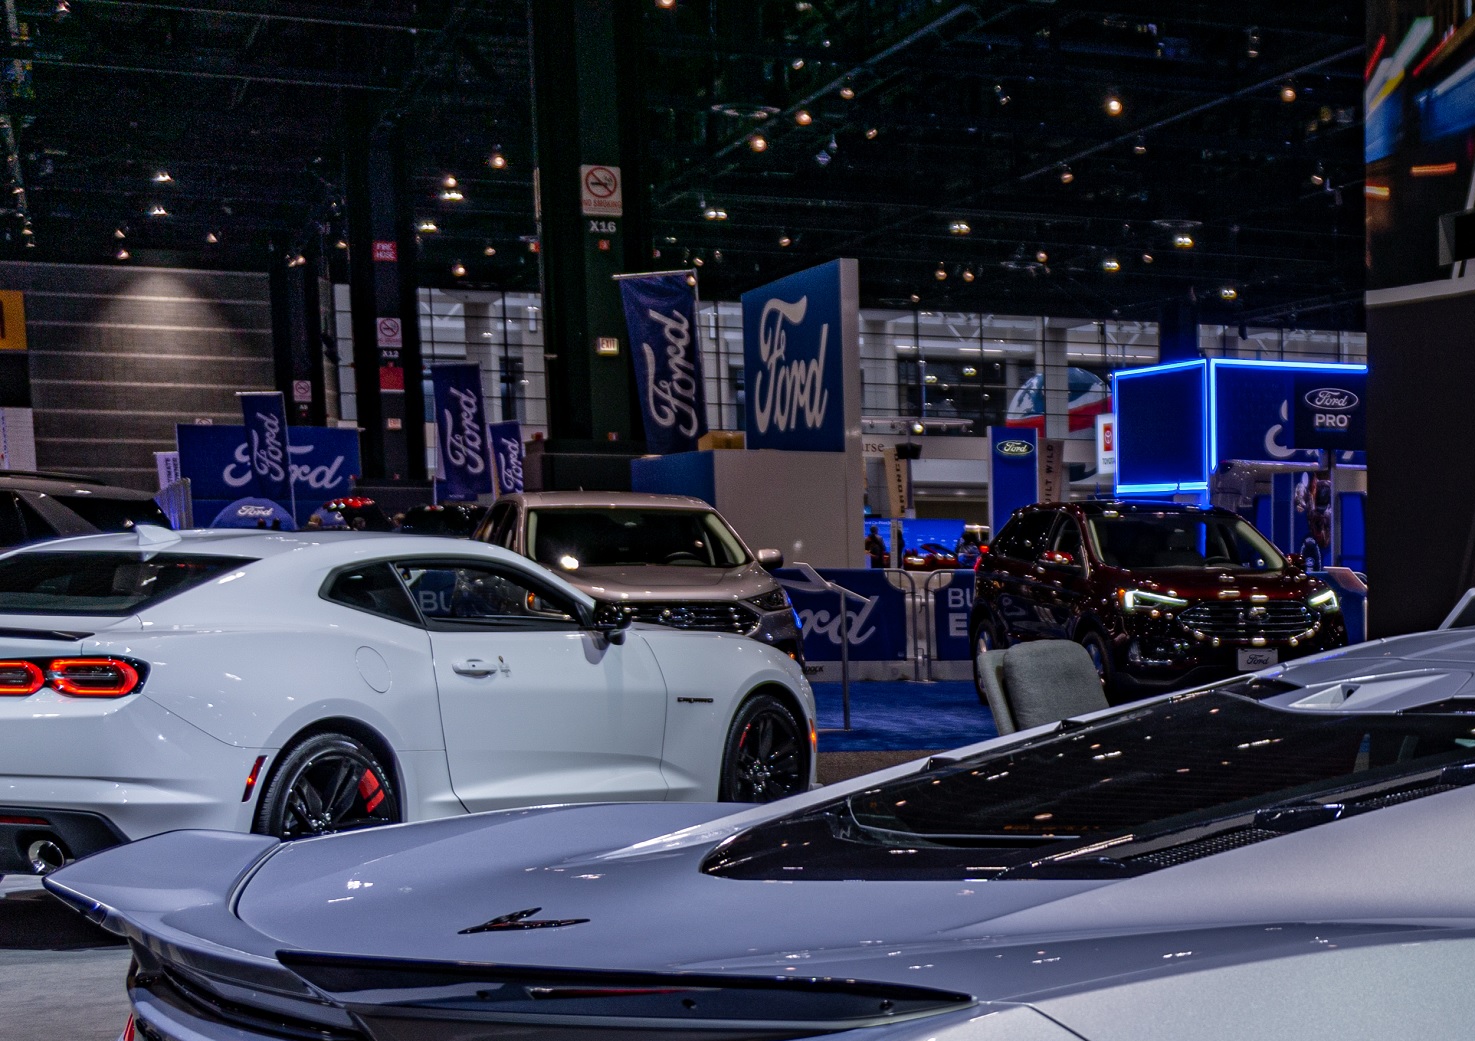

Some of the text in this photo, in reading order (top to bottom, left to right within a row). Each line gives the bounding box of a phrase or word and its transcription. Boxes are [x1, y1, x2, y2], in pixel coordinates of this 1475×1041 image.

[590, 220, 617, 233] X16
[601, 339, 616, 349] EXIT
[755, 294, 829, 434] Ford
[642, 308, 699, 438] Ford
[1315, 390, 1349, 406] Ford
[444, 386, 485, 474] Ford
[252, 412, 285, 482] Ford
[1003, 441, 1028, 453] Ford
[237, 504, 274, 517] Ford
[1246, 654, 1270, 665] Ford
